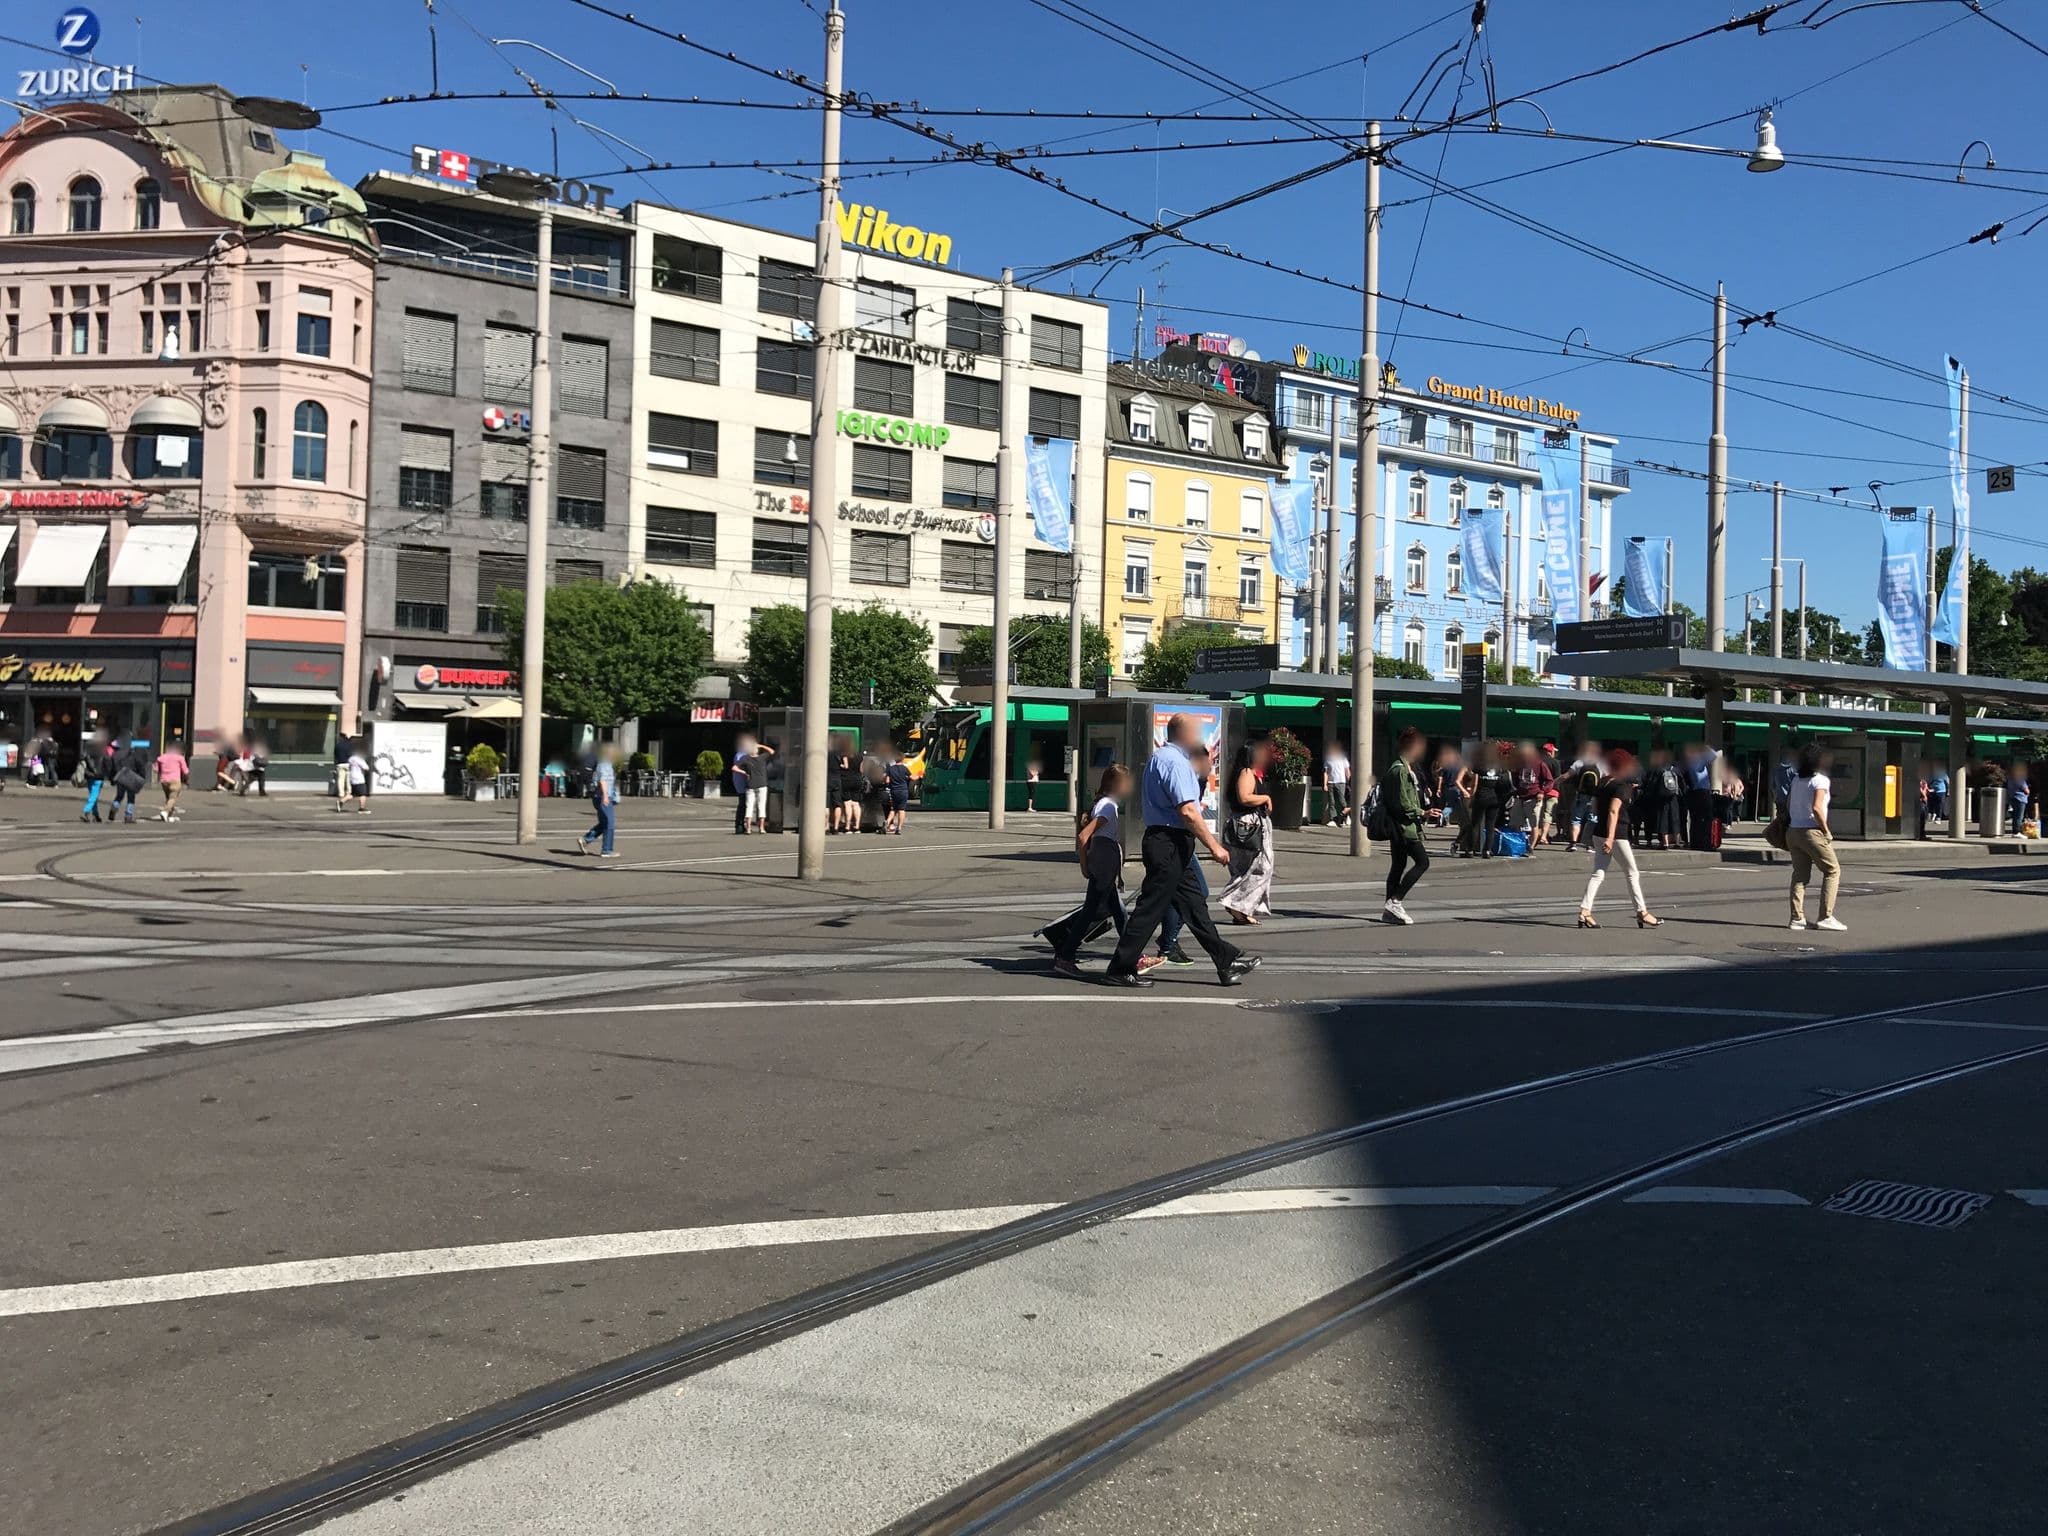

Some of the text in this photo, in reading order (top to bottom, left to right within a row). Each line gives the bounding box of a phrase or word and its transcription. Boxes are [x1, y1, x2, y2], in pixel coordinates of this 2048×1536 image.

[61, 15, 92, 48] Z
[17, 64, 136, 97] ZURICH
[836, 199, 952, 265] Nikon
[1313, 351, 1360, 377] ROL
[1427, 375, 1581, 422] Grand Hotel Euler
[836, 410, 951, 450] IGICOMP
[1990, 470, 2012, 489] 25
[754, 489, 786, 513] The
[838, 500, 890, 526] School
[894, 508, 912, 530] of
[911, 509, 973, 534] Business
[1671, 621, 1685, 640] D
[28, 661, 104, 682] Tchibo
